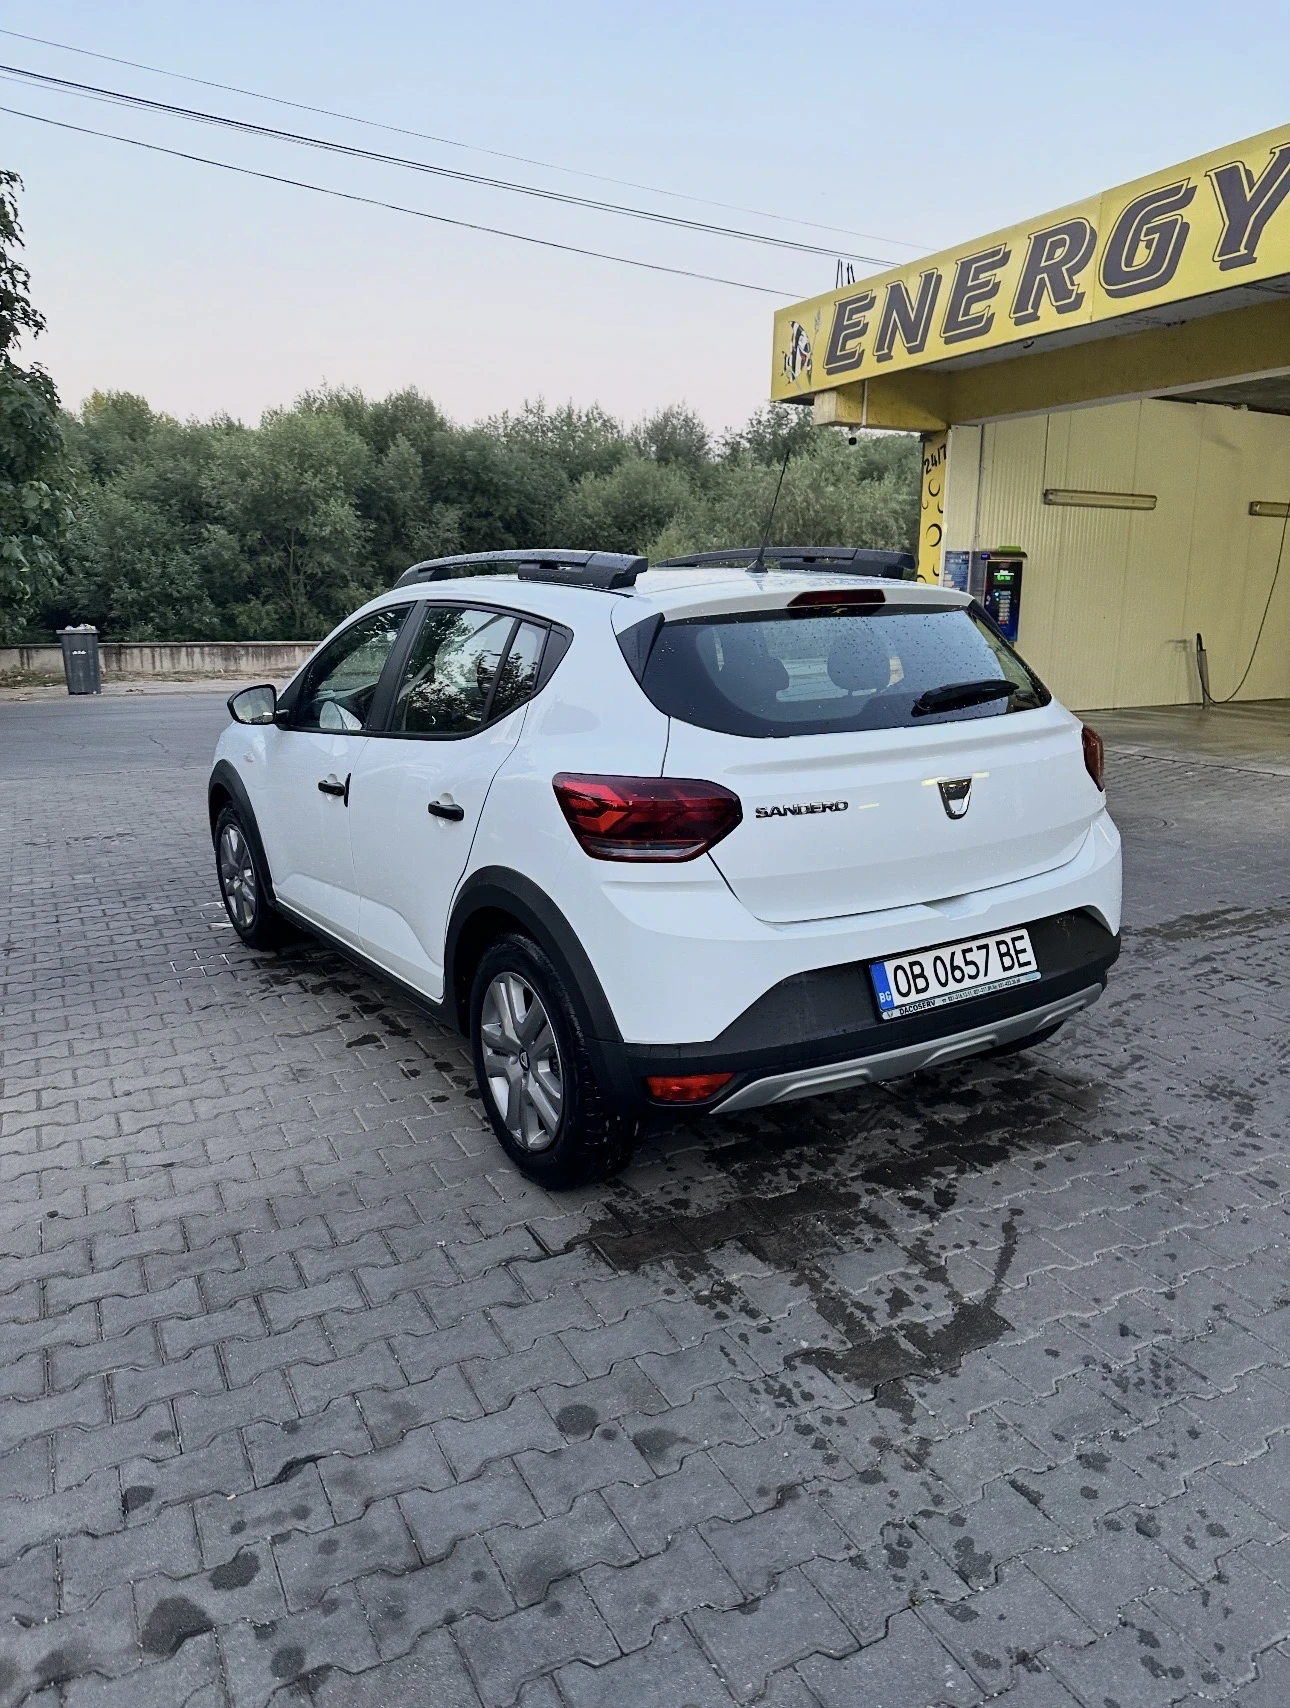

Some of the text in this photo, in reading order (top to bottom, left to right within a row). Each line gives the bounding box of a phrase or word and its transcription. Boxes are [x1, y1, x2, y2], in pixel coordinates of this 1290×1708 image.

[822, 142, 1290, 375] ENERGY
[923, 443, 947, 475] 24/7
[755, 800, 849, 819] SANDERO
[893, 960, 930, 998] OB
[933, 943, 990, 988] 0657
[995, 935, 1032, 973] BE
[879, 991, 892, 1003] BG
[899, 1000, 936, 1015] DACOSERV
